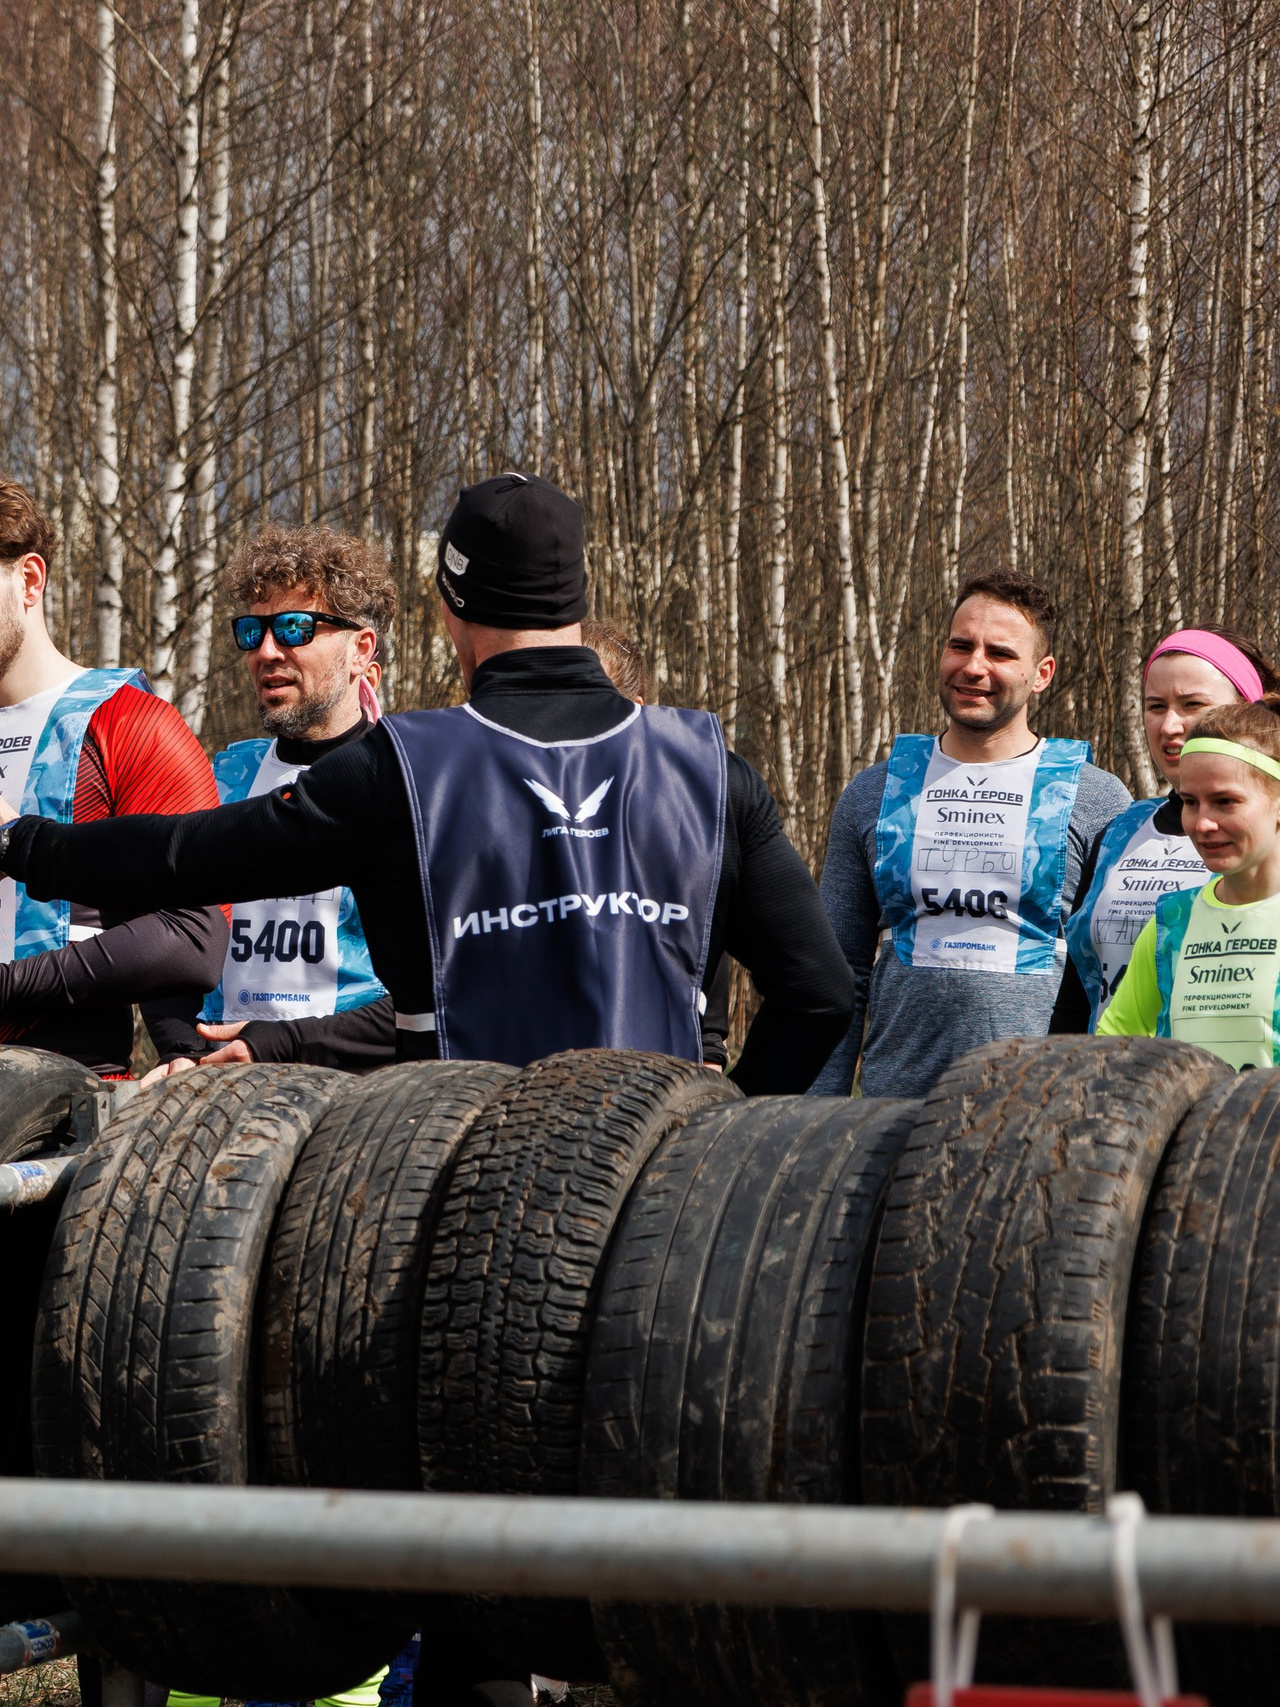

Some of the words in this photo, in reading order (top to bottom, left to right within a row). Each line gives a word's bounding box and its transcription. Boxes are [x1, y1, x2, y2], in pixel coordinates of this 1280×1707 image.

[927, 789, 968, 799] ГОНКА
[973, 790, 1023, 803] ГЕРОЕВ
[937, 807, 1005, 824] Sminex
[542, 826, 569, 838] ЛИГА
[569, 827, 609, 838] ГЕРОЕВ
[920, 846, 1014, 875] ТУРБО
[1120, 858, 1158, 868] ГОНКА
[1118, 876, 1185, 892] Sminex
[921, 888, 1008, 919] 5406
[453, 892, 690, 938] ИНСТРУКТОР
[231, 919, 325, 964] 5400
[944, 941, 996, 951] ГАЗПРОМБАНК
[1185, 941, 1222, 954] ГОНКА
[1224, 938, 1277, 951] ГЕРОЕВ
[1188, 964, 1256, 984] Sminex
[252, 993, 310, 1003] ГАЗПРОМБАНК
[1184, 993, 1252, 1001] ПЕРФЕКЦИОНИСТЫ
[1199, 1003, 1250, 1011] DEVELOPMENT
